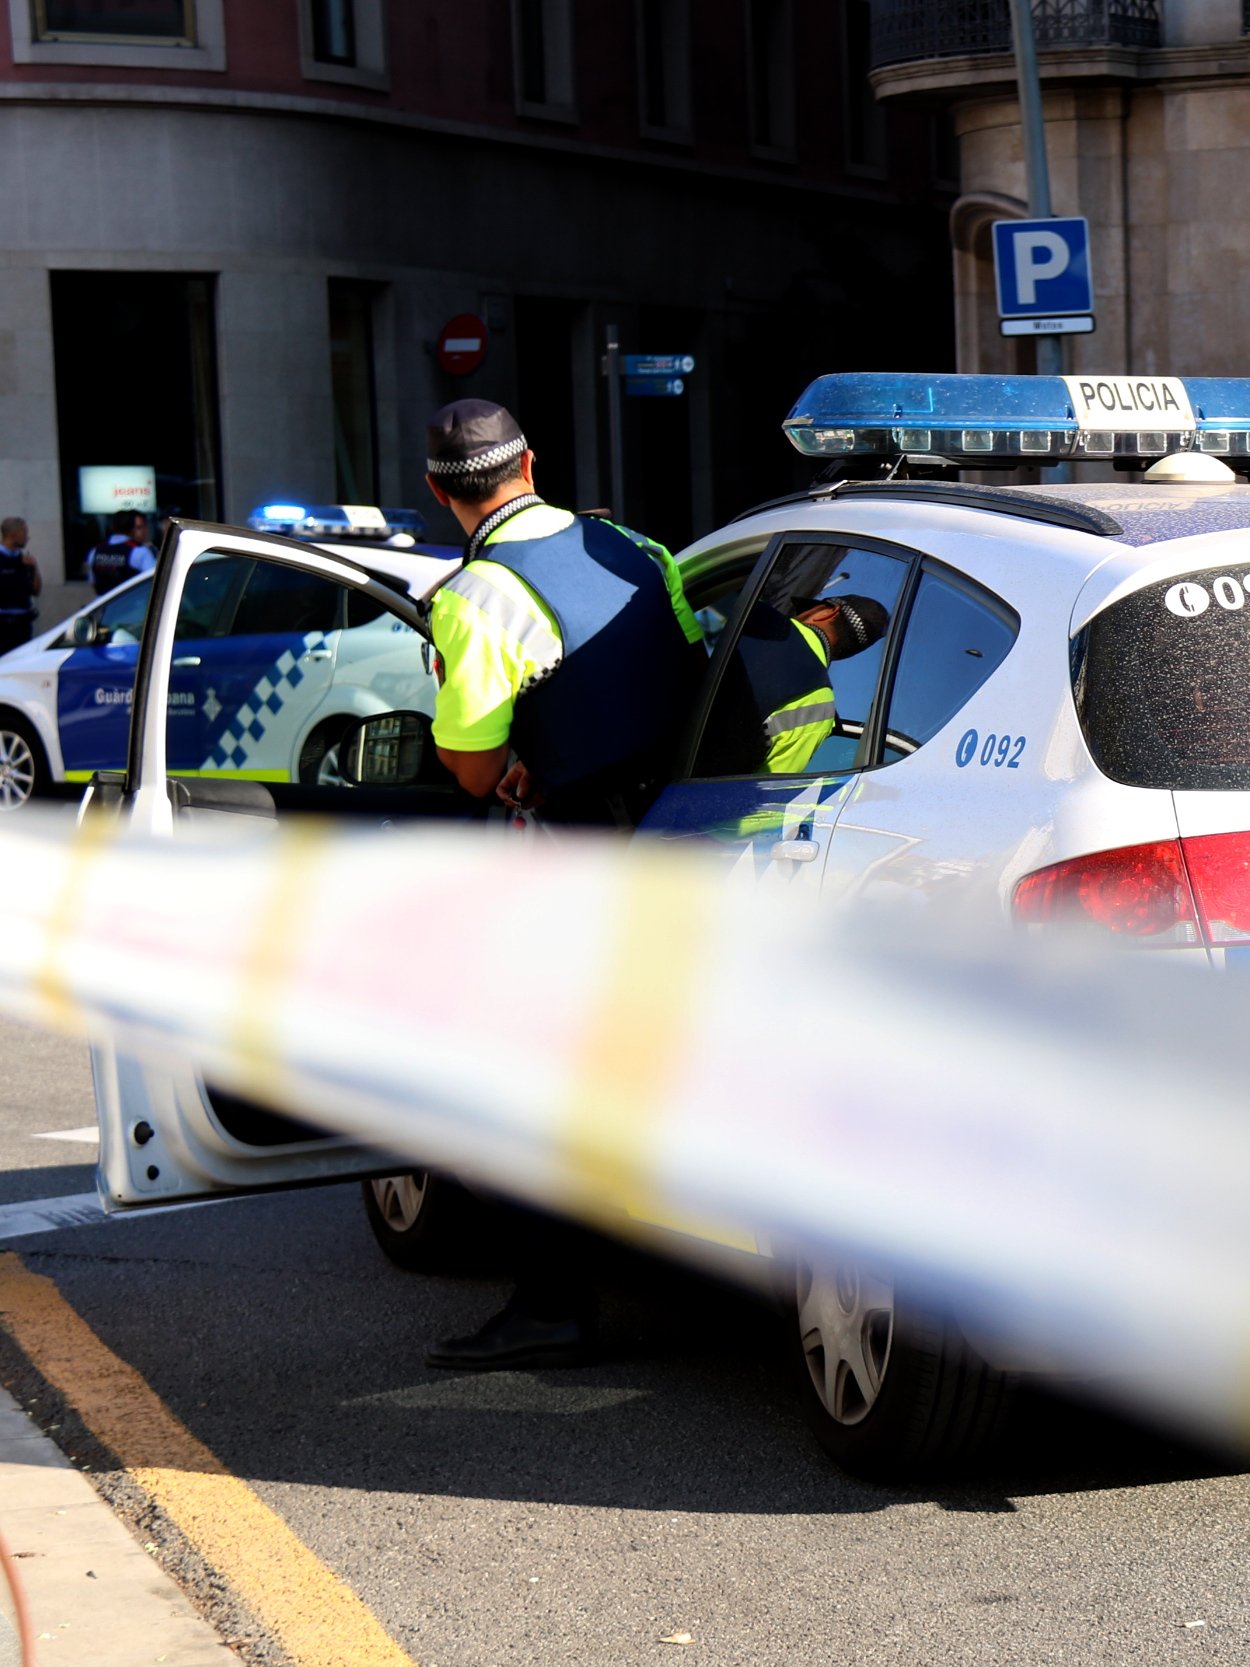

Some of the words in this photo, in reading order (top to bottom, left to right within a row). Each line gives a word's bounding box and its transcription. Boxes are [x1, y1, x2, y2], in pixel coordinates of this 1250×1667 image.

[1013, 231, 1070, 305] P
[1079, 382, 1180, 411] POLICIA
[95, 687, 133, 704] Guàrd
[980, 733, 1026, 769] 092
